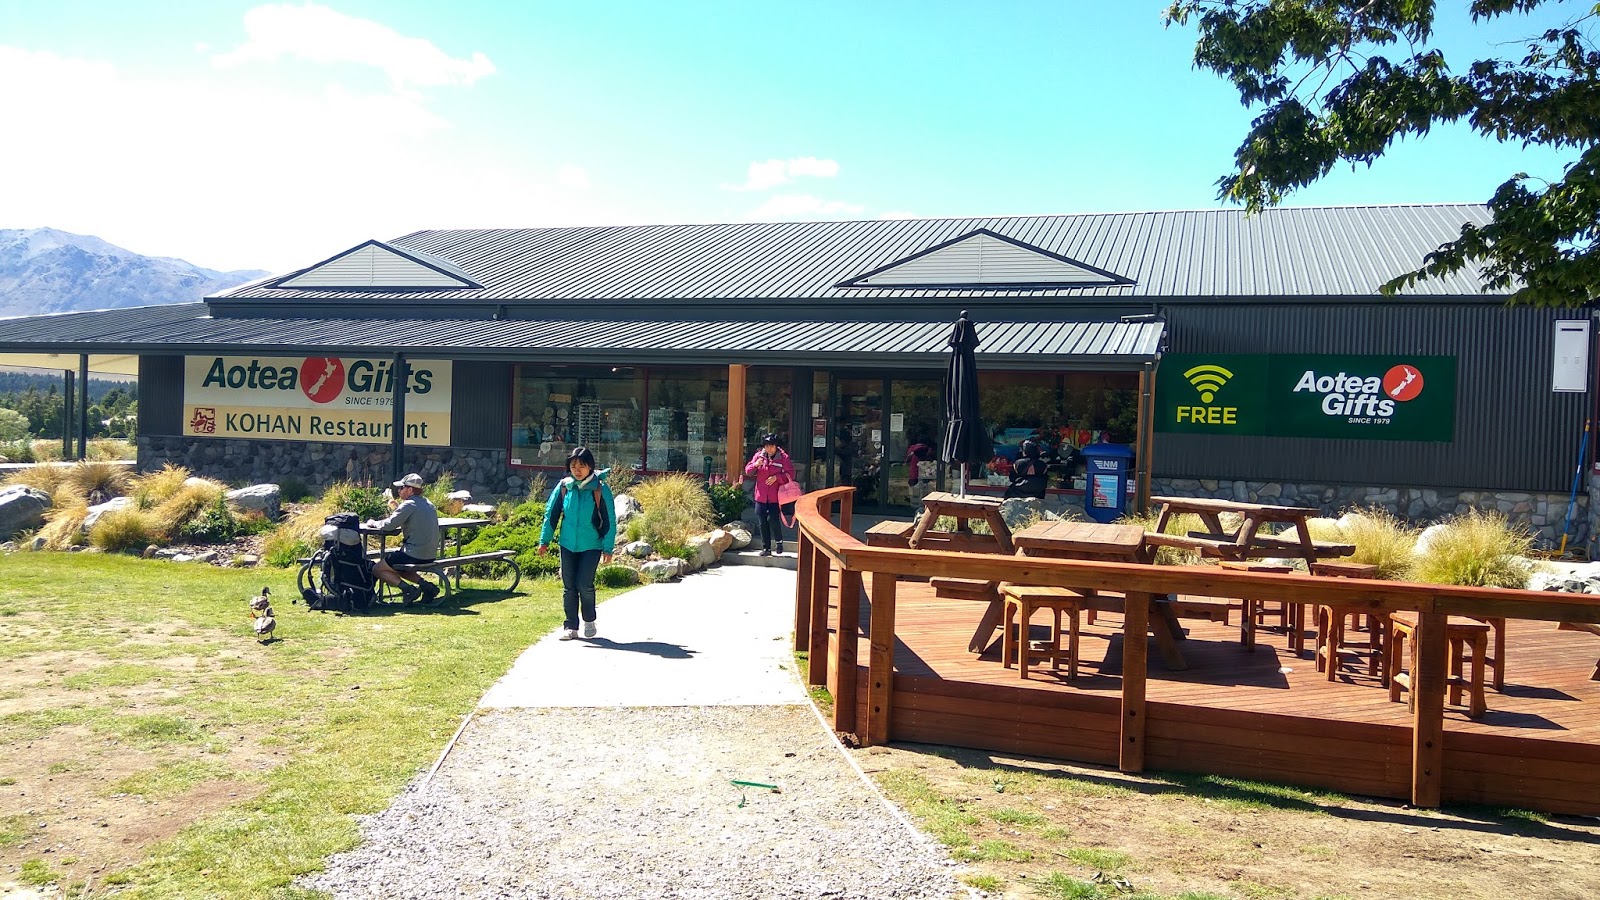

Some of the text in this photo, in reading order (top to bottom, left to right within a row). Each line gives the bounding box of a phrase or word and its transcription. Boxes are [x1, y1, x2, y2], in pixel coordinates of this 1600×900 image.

[202, 357, 298, 390] Aotea
[1293, 370, 1381, 394] Aotea
[344, 396, 372, 406] SINCE
[1321, 392, 1395, 417] Gifts
[226, 413, 428, 439] KOHAN Restaurnt
[1176, 406, 1238, 424] FREE
